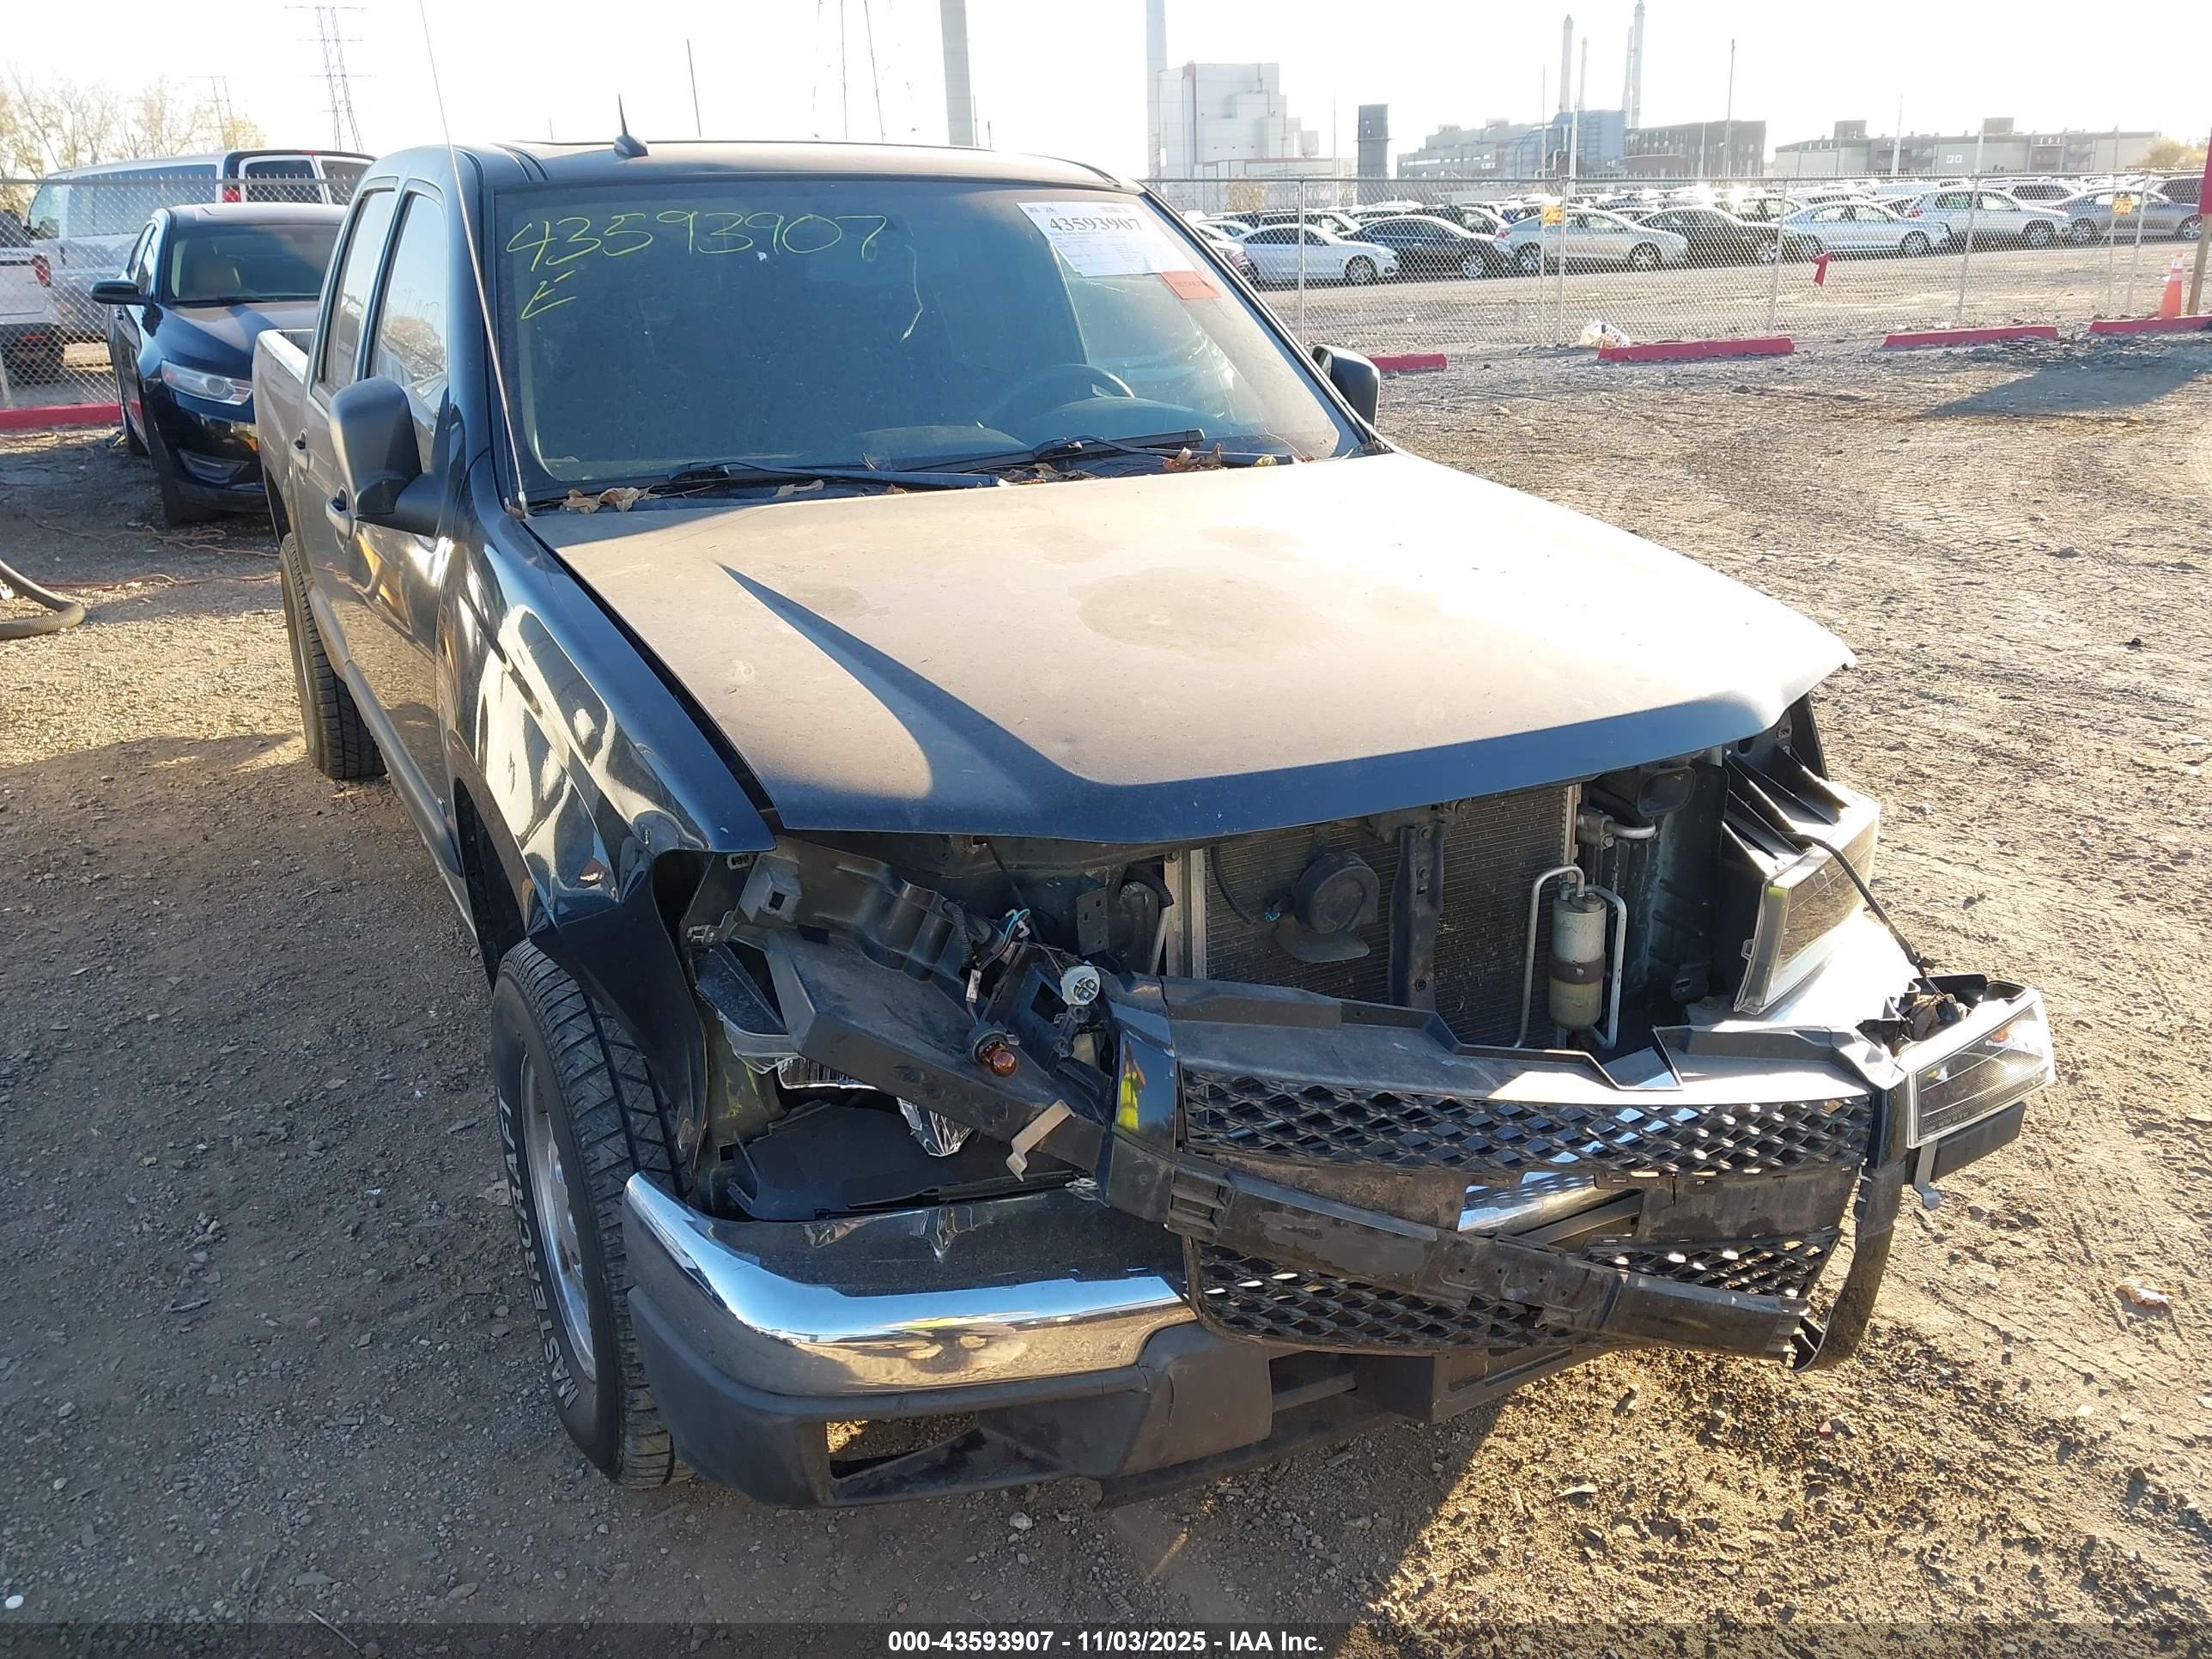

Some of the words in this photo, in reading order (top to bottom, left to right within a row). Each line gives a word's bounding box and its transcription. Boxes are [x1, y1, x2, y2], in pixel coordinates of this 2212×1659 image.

[506, 210, 887, 272] 43593907
[1049, 216, 1142, 232] 43593907
[498, 1086, 580, 1409] MASTERCRAFT
